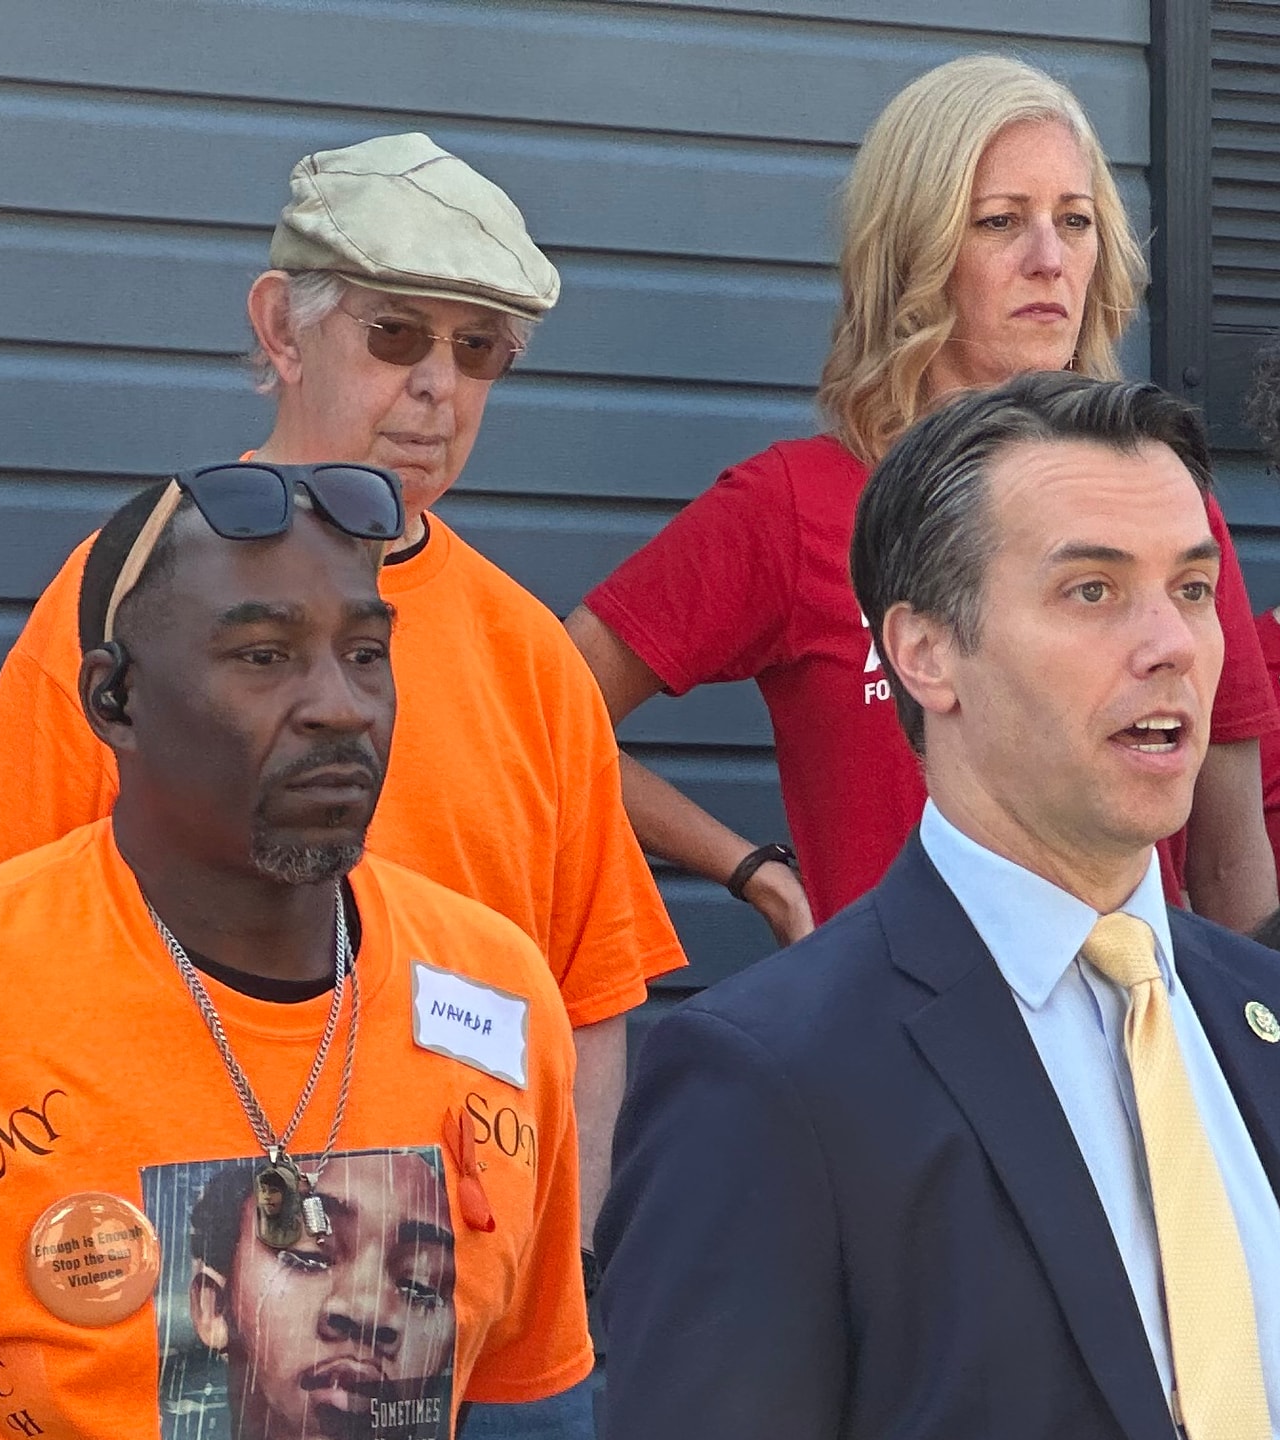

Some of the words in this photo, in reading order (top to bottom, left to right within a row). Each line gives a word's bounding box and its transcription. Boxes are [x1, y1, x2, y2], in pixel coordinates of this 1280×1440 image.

[864, 679, 891, 705] FO
[34, 1234, 81, 1258] Enough
[82, 1235, 95, 1248] is
[96, 1224, 143, 1245] Enough
[52, 1257, 81, 1273] Stop
[83, 1251, 105, 1266] the
[67, 1267, 124, 1288] Violence
